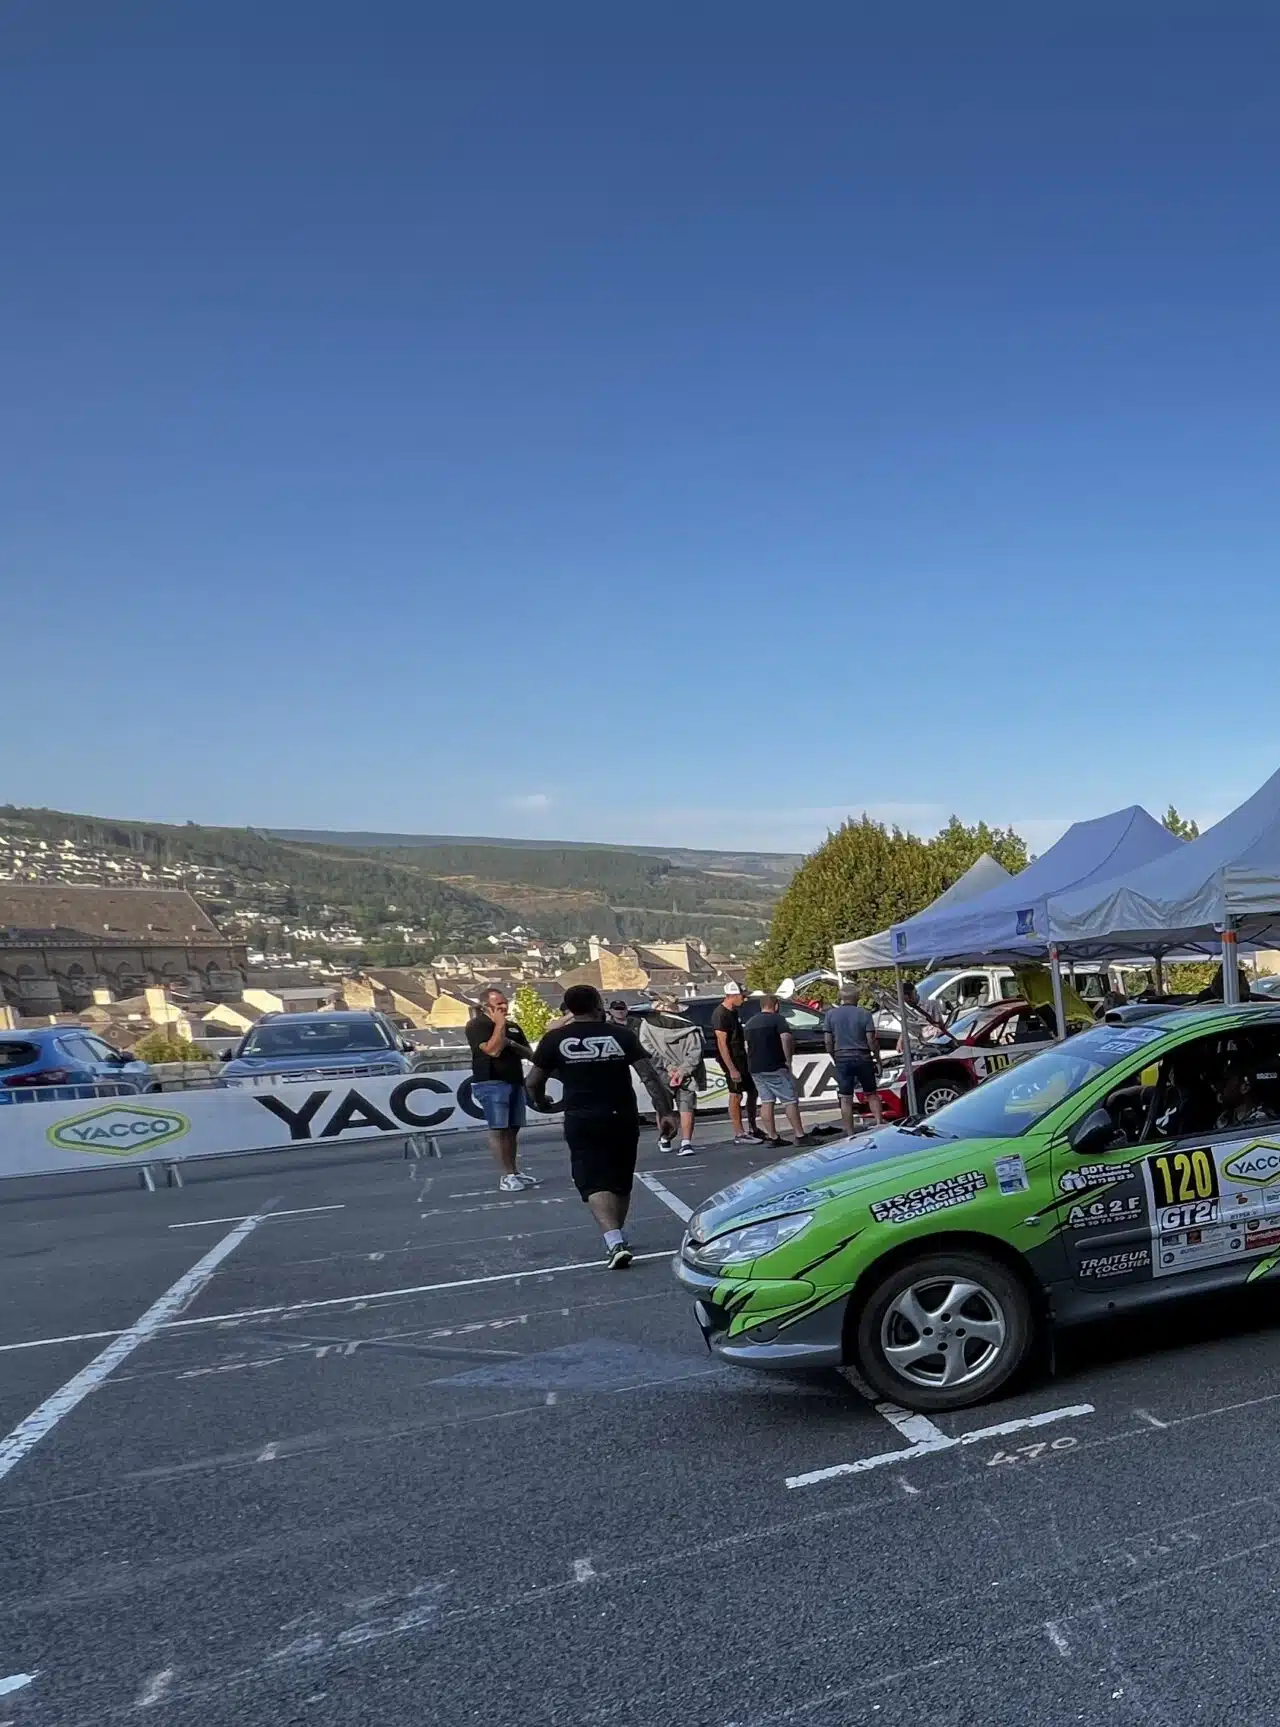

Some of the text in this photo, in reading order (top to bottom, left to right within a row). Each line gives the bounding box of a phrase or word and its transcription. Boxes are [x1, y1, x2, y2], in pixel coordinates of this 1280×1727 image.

[559, 1036, 626, 1059] CSA
[72, 1119, 171, 1142] YACCO
[908, 1170, 985, 1201] CHALEIL
[1156, 1150, 1213, 1205] 120
[875, 1179, 987, 1222] PAYSAGISTE
[893, 1193, 975, 1224] COURPIERE
[1080, 1268, 1093, 1277] LE
[1095, 1258, 1151, 1274] COCOTIER
[1081, 1250, 1148, 1269] TRAITEUR
[986, 1436, 1078, 1467] 470
